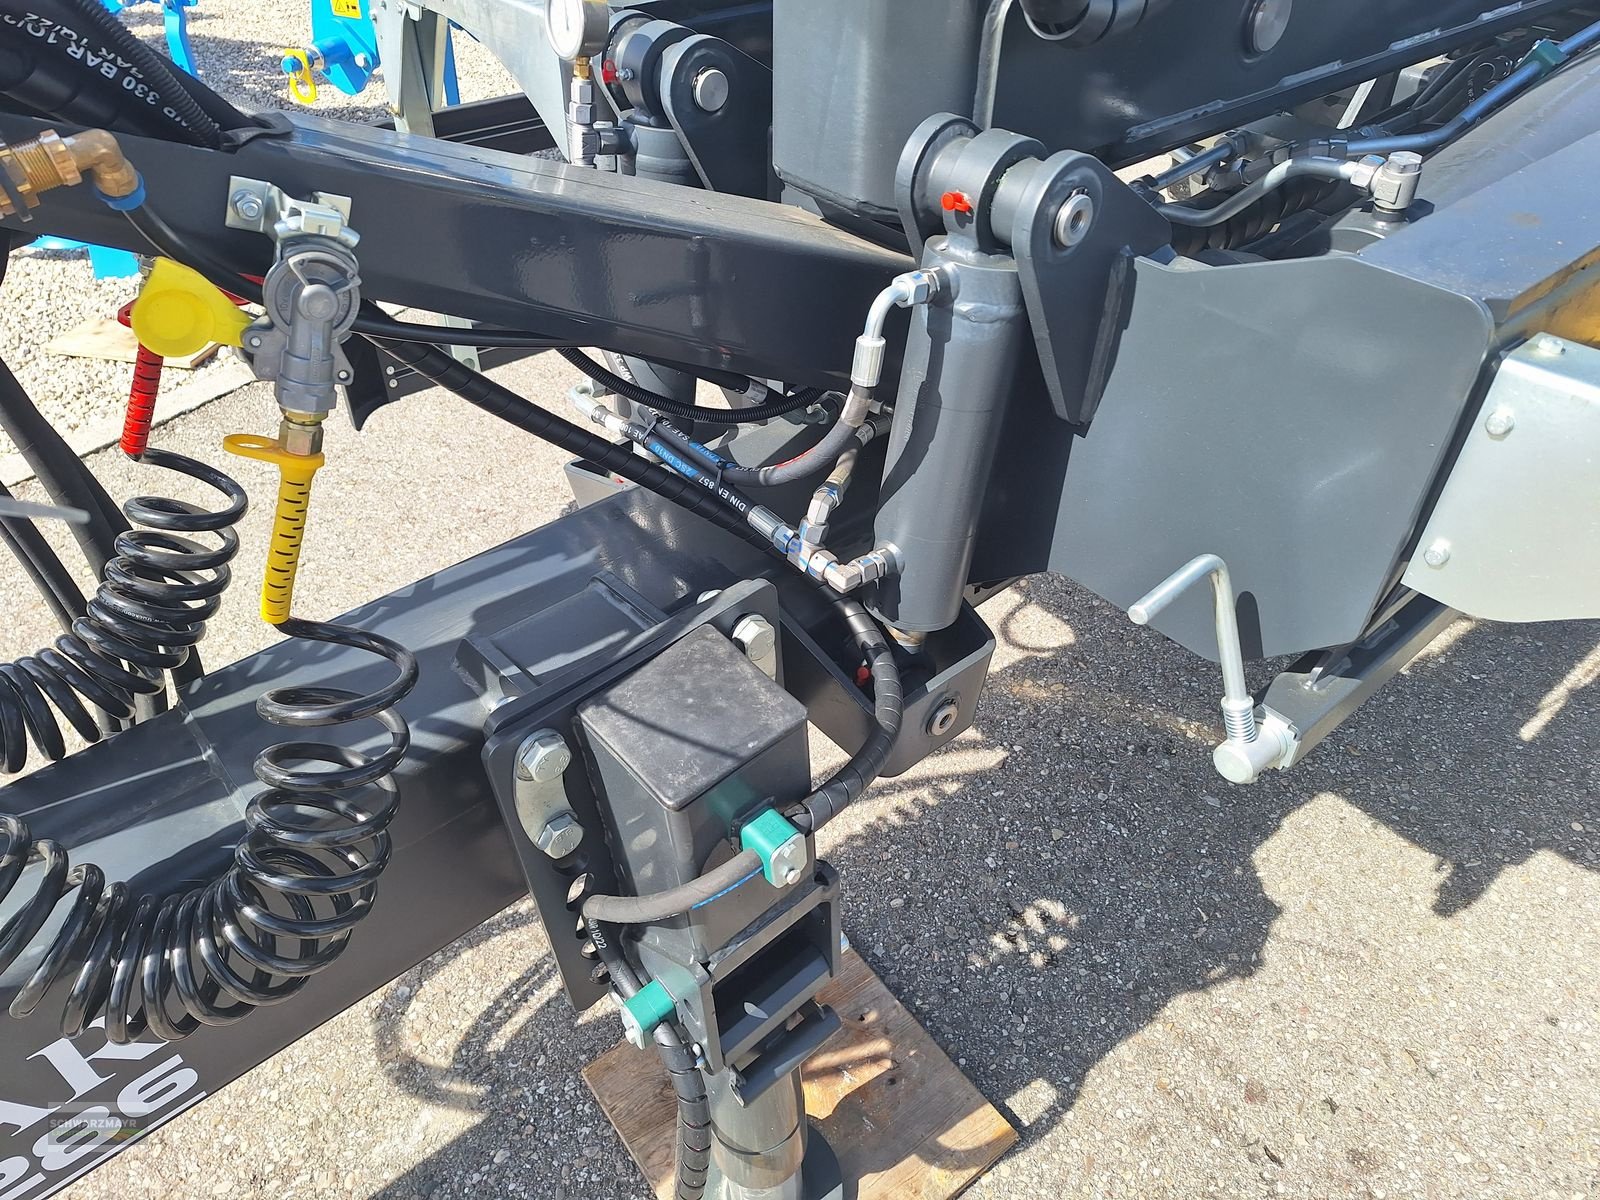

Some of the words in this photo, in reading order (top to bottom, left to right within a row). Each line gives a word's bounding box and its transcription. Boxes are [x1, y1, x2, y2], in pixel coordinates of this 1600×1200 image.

[66, 41, 118, 79] BAR
[122, 76, 160, 105] 330
[654, 445, 675, 462] DN10
[675, 460, 693, 475] 2SC
[698, 476, 715, 489] 857
[729, 495, 747, 512] DIN
